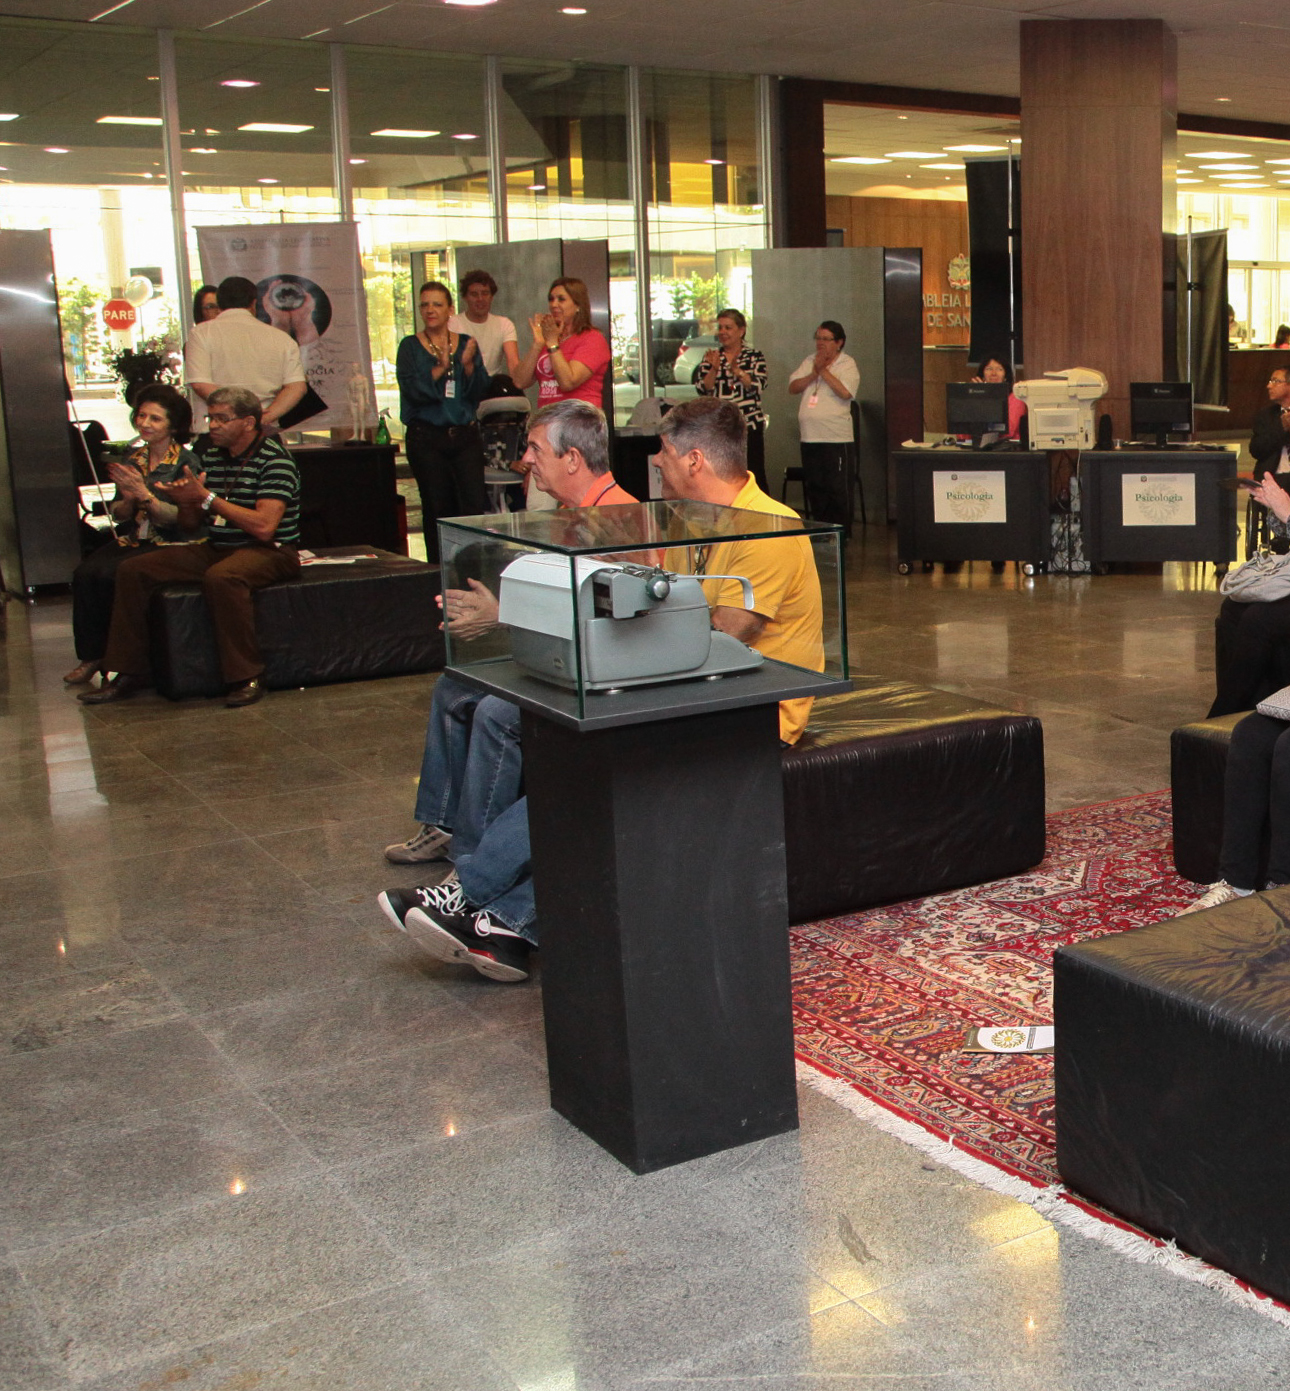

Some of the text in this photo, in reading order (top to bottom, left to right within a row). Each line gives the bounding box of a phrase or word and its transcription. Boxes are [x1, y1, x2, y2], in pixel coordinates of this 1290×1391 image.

[103, 310, 135, 320] PARE
[927, 313, 944, 327] DE
[304, 367, 335, 376] OGIA
[946, 492, 993, 502] Psicologia
[1135, 494, 1183, 504] Psicologia
